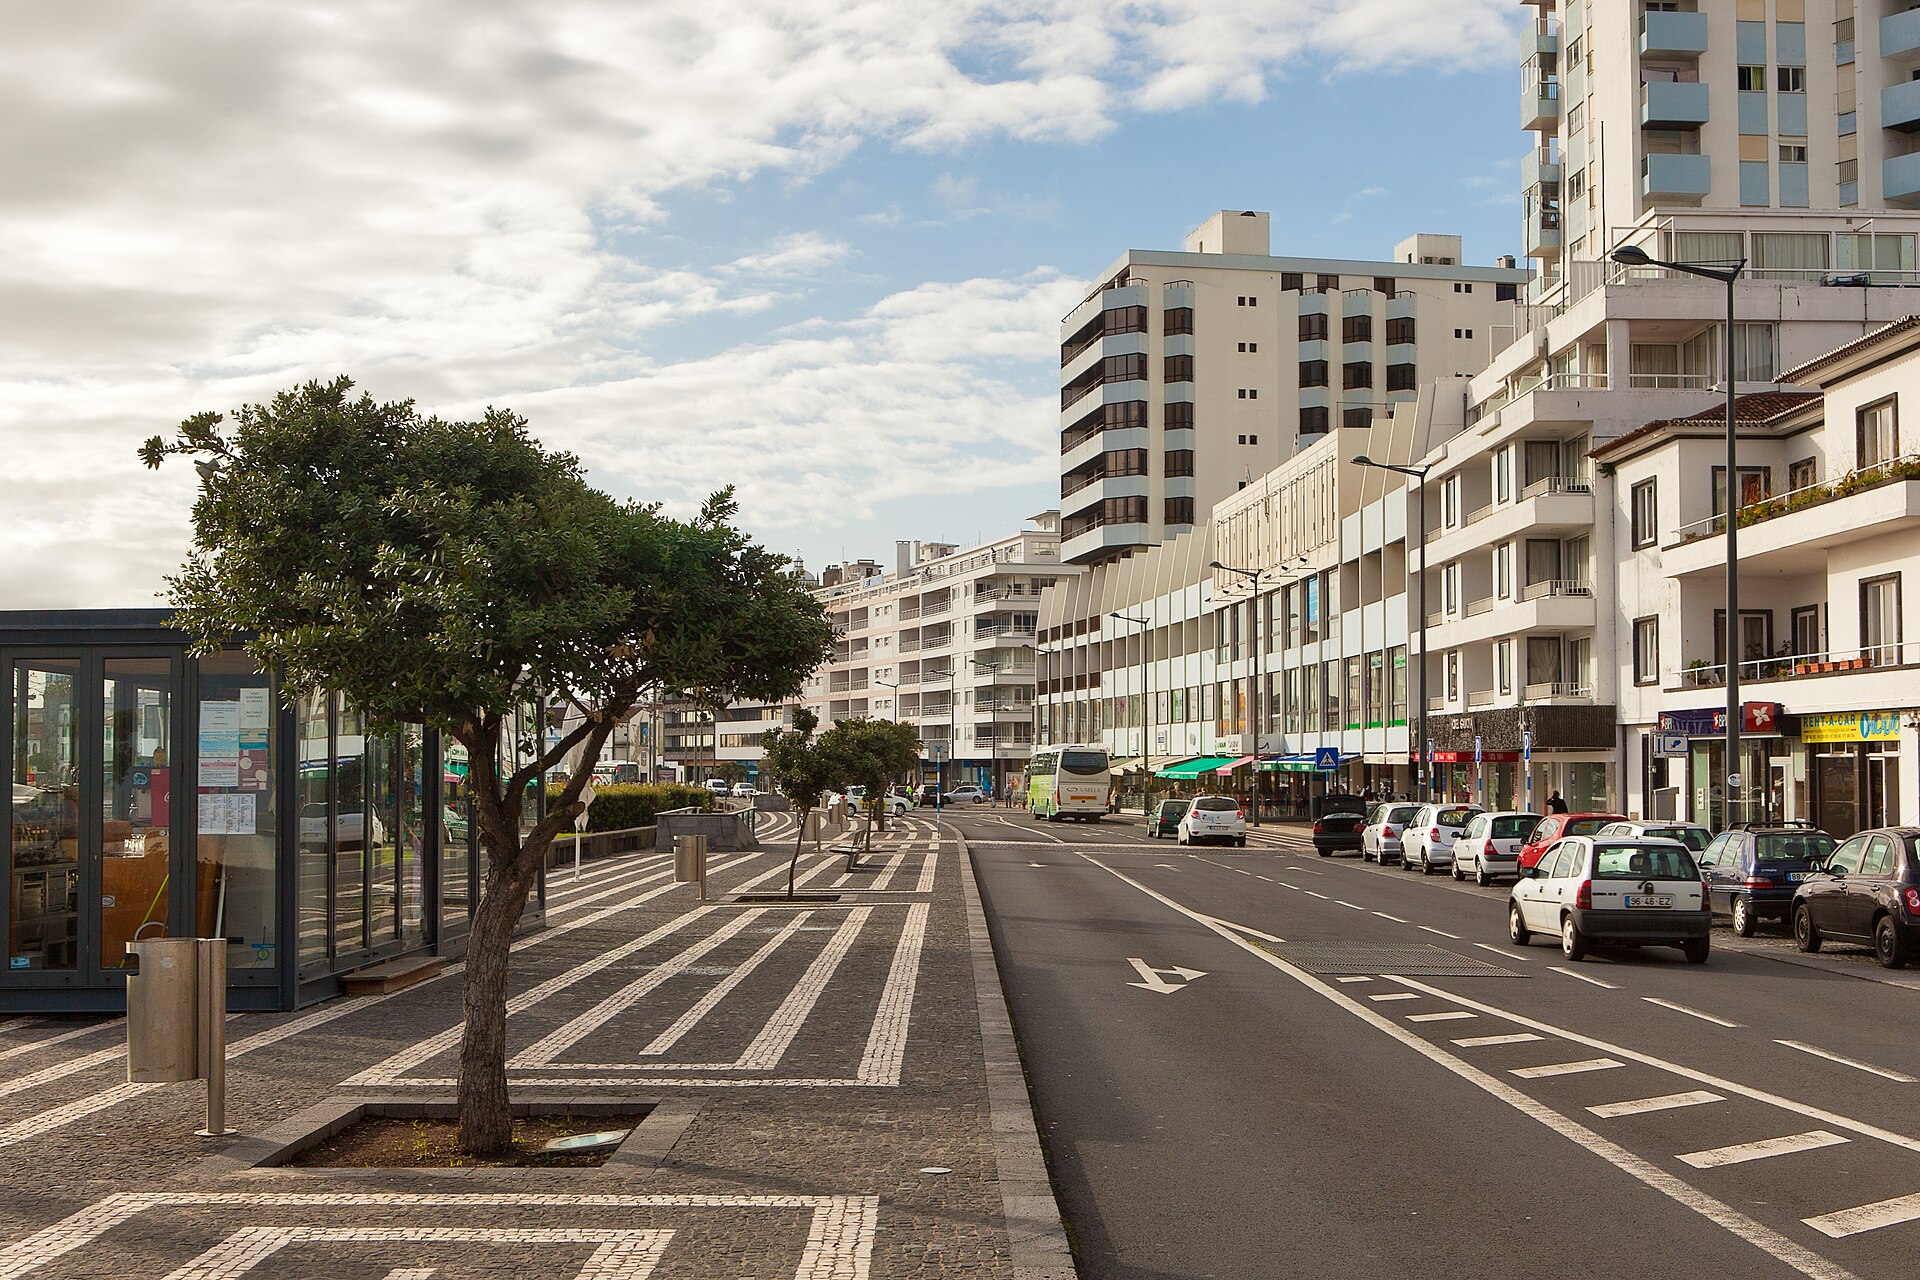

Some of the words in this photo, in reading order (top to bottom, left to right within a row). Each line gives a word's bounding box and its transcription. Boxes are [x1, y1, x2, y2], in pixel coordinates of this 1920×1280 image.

[1664, 717, 1672, 730] BPI
[1803, 713, 1856, 727] RENT-A-CAR
[1630, 897, 1671, 906] 96-46-EZ
